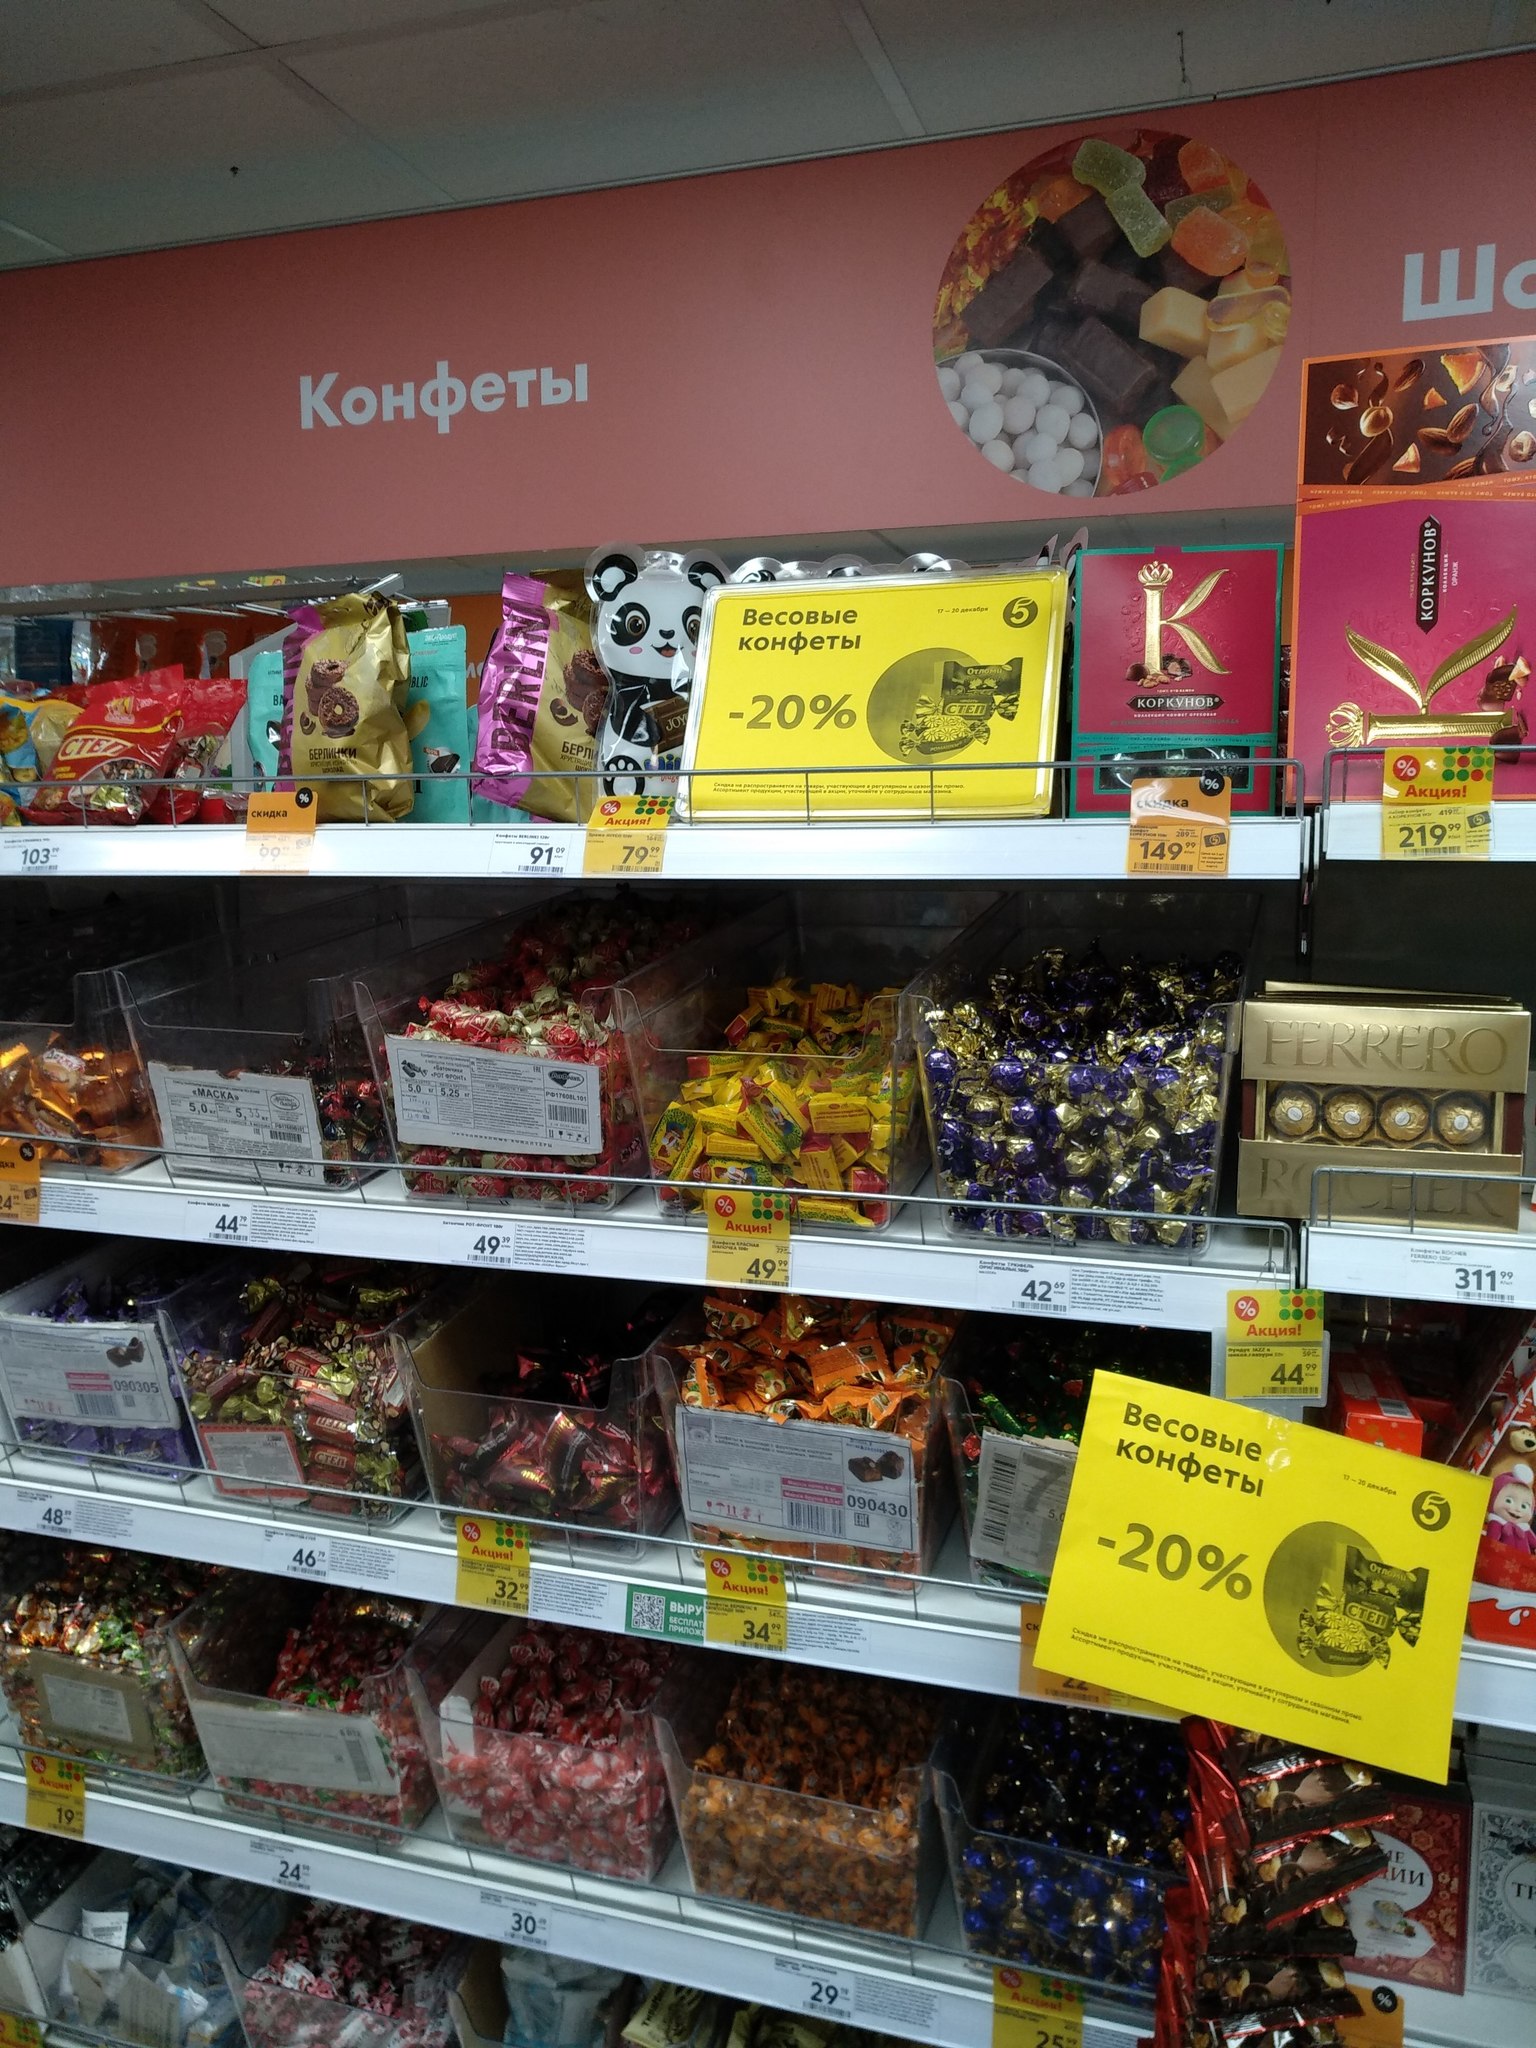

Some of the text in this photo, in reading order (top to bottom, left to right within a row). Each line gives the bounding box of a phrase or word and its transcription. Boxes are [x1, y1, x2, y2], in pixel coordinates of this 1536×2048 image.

[300, 361, 589, 434] Конфеты
[1420, 527, 1437, 621] КОРКУНОВ
[742, 607, 858, 627] Весовые
[960, 606, 989, 614] декабря
[738, 631, 862, 656] конфеты
[729, 693, 857, 731] -20%
[945, 703, 986, 715] СТЕП
[1137, 696, 1214, 709] КОРКУНОВ
[308, 747, 357, 760] БЕРЛИНКИ
[1405, 784, 1468, 800] Акция!
[251, 808, 288, 819] скидка
[604, 817, 652, 826] Акция!
[1399, 824, 1447, 849] 219
[1447, 823, 1462, 832] 99
[21, 848, 51, 865] 103
[530, 846, 554, 865] 91
[622, 845, 661, 865] 79 99
[1139, 840, 1183, 861] 149
[1185, 841, 1197, 849] 99
[1263, 1019, 1508, 1076] FERRERO
[192, 1088, 240, 1101] «МАСКА»
[188, 1102, 208, 1116] 5,0
[215, 1214, 248, 1233] 44 79
[725, 1220, 773, 1235] Акция!
[473, 1235, 511, 1255] 49 39
[746, 1257, 788, 1279] 49 99
[1454, 1267, 1514, 1292] 311 99
[1021, 1279, 1066, 1302] 42 69
[1246, 1323, 1302, 1338] Акция!
[1270, 1363, 1317, 1386] 44 99
[113, 1379, 160, 1393] 090305
[1123, 1402, 1263, 1462] Весовые
[314, 1452, 348, 1468] СТЕП
[1116, 1438, 1264, 1498] конфеты
[1367, 1481, 1398, 1496] декабря
[847, 1494, 908, 1518] 090430
[42, 1507, 64, 1526] 48
[292, 1548, 317, 1568] 46
[471, 1545, 514, 1561] Акция!
[1096, 1522, 1252, 1600] -20%
[494, 1579, 518, 1601] 32
[722, 1580, 769, 1596] Акция!
[669, 1601, 704, 1616] ВЫРУ
[1347, 1603, 1388, 1627] СТЕП
[668, 1616, 704, 1629] БЕСПЛАТ
[743, 1619, 781, 1642] 34 99
[1070, 1633, 1116, 1653] Ассортимент
[1072, 1627, 1098, 1640] Скидка
[1108, 1638, 1172, 1662] распространяется
[56, 1807, 75, 1824] 19
[279, 1860, 301, 1881] 24
[511, 1912, 537, 1935] 30
[810, 1982, 839, 2005] 29
[1036, 2030, 1064, 2048] 25
